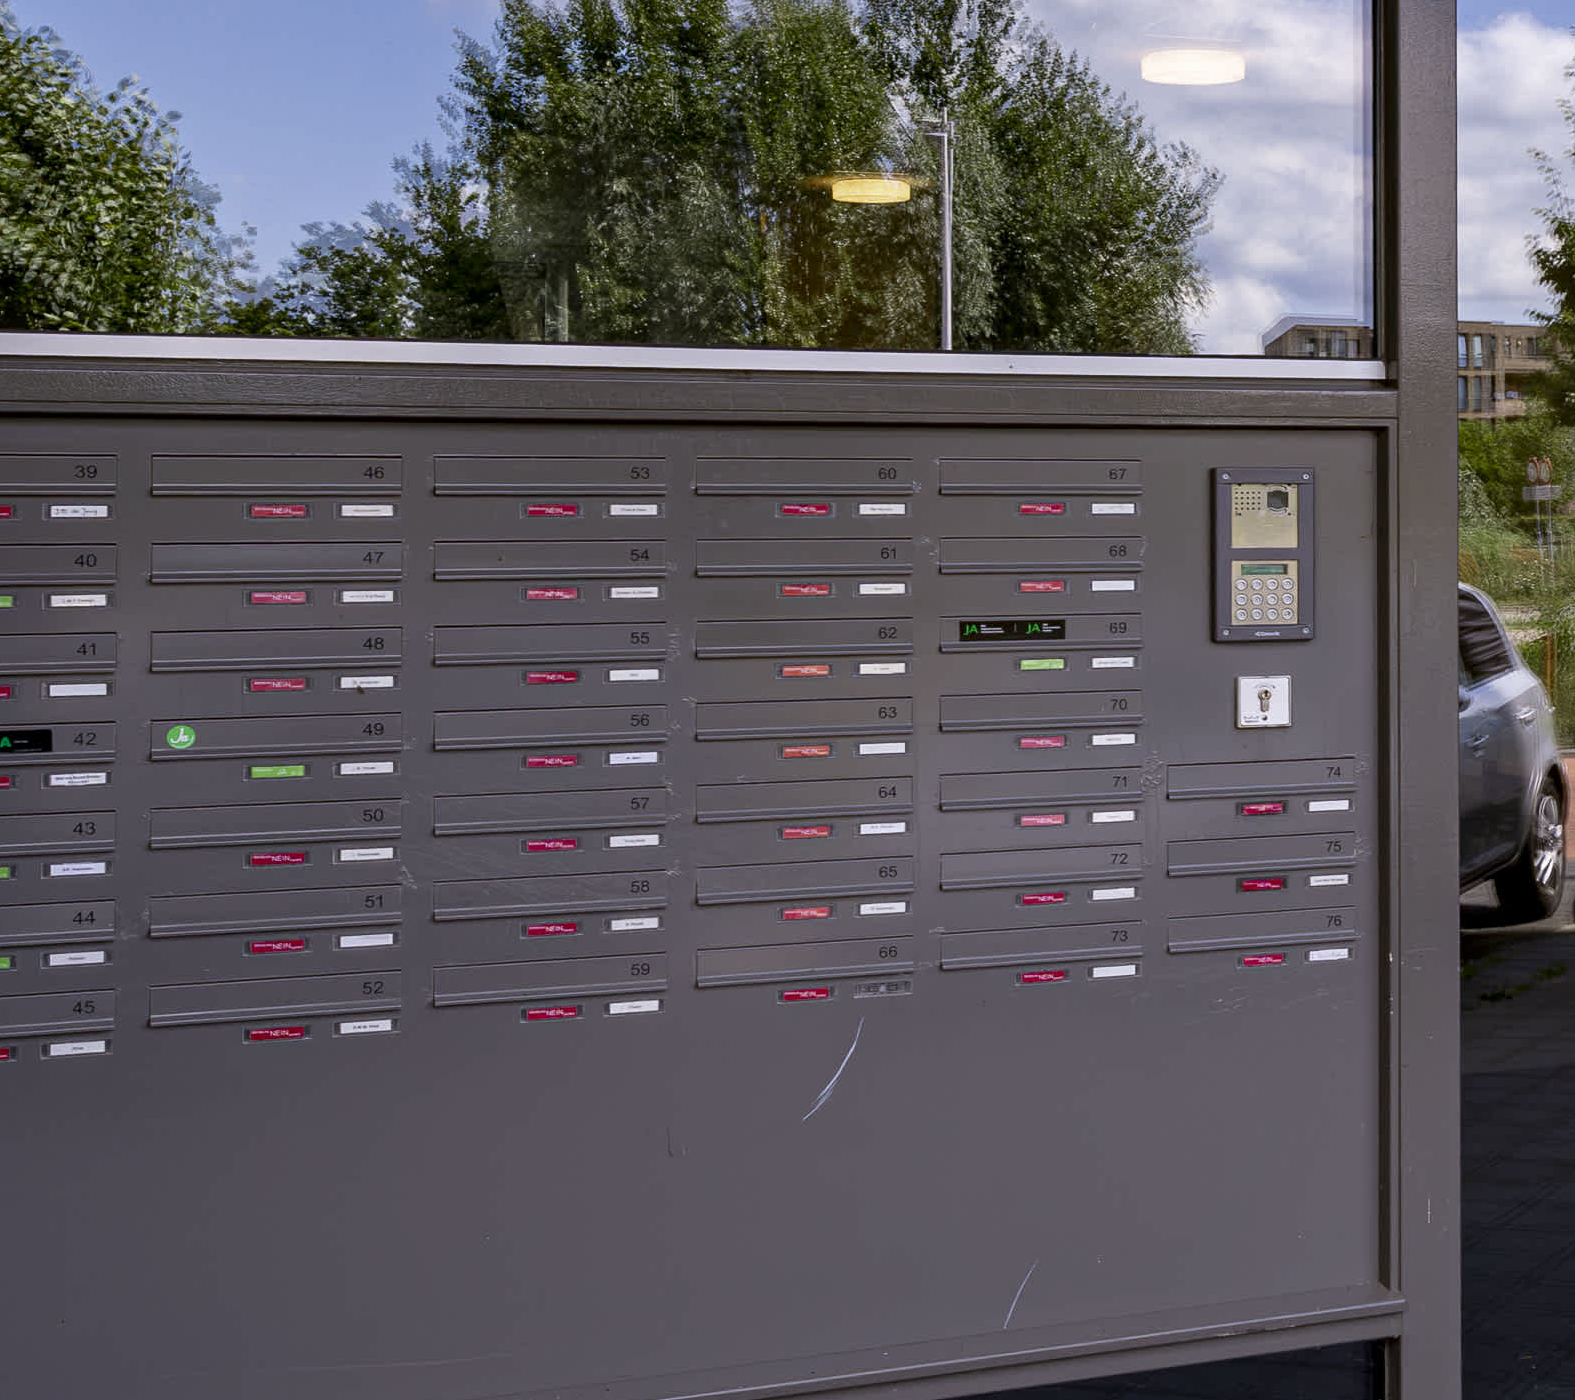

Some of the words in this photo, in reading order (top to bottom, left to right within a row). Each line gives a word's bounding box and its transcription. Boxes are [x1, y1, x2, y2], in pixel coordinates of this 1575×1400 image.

[74, 464, 98, 479] 39
[363, 466, 385, 480] 46
[630, 466, 650, 480] 53
[878, 467, 897, 480] 60
[1108, 468, 1127, 480] 67
[362, 551, 384, 564] 47
[630, 549, 650, 562] 54
[880, 547, 897, 560] 61
[1108, 544, 1127, 558] 68
[74, 553, 98, 568] 40
[878, 626, 898, 640] 62
[963, 623, 978, 635] JA
[1025, 622, 1040, 634] JA
[1109, 621, 1127, 634] 69
[362, 637, 385, 650] 48
[630, 631, 650, 645] 55
[76, 642, 96, 656] 41
[1110, 698, 1128, 711] 70
[878, 706, 898, 720] 63
[630, 713, 650, 728] 56
[170, 727, 188, 743] Ja
[362, 722, 385, 736] 49
[73, 732, 97, 746] 42
[1326, 766, 1342, 778] 74
[1112, 775, 1128, 788] 71
[878, 786, 897, 799] 64
[630, 797, 650, 811] 57
[362, 808, 384, 823] 50
[72, 821, 96, 836] 43
[1325, 840, 1342, 853] 75
[1110, 853, 1129, 865] 72
[878, 865, 898, 879] 65
[630, 880, 650, 894] 58
[364, 894, 383, 909] 51
[72, 910, 96, 925] 44
[1327, 914, 1342, 928] 76
[1112, 930, 1129, 943] 73
[878, 945, 898, 959] 66
[630, 962, 651, 976] 59
[362, 981, 384, 995] 52
[72, 1000, 95, 1015] 45
